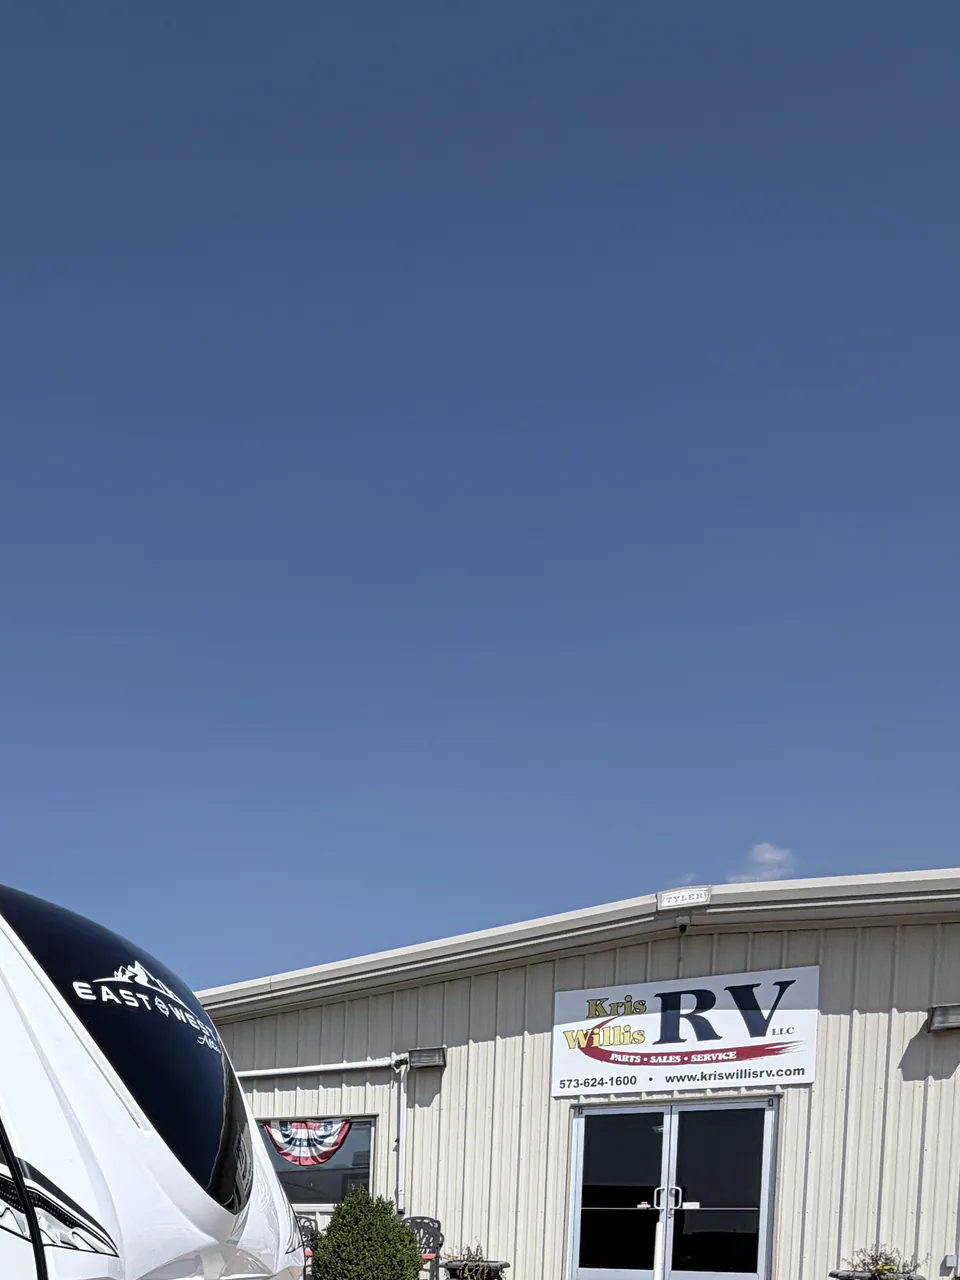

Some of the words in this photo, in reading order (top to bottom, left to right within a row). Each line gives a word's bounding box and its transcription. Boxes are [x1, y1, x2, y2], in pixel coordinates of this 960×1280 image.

[665, 892, 704, 904] TYLER
[72, 981, 152, 1011] EAST
[168, 1003, 217, 1042] WEST
[586, 994, 648, 1019] Kris
[652, 979, 797, 1045] RV
[562, 1025, 646, 1050] Willis
[771, 1027, 795, 1037] LLC
[609, 1053, 641, 1063] PARTS
[649, 1055, 681, 1064] SALES
[690, 1051, 737, 1063] SERVICE
[559, 1075, 637, 1089] 573-624-1600
[664, 1067, 806, 1084] www.kriswillisrv.com
